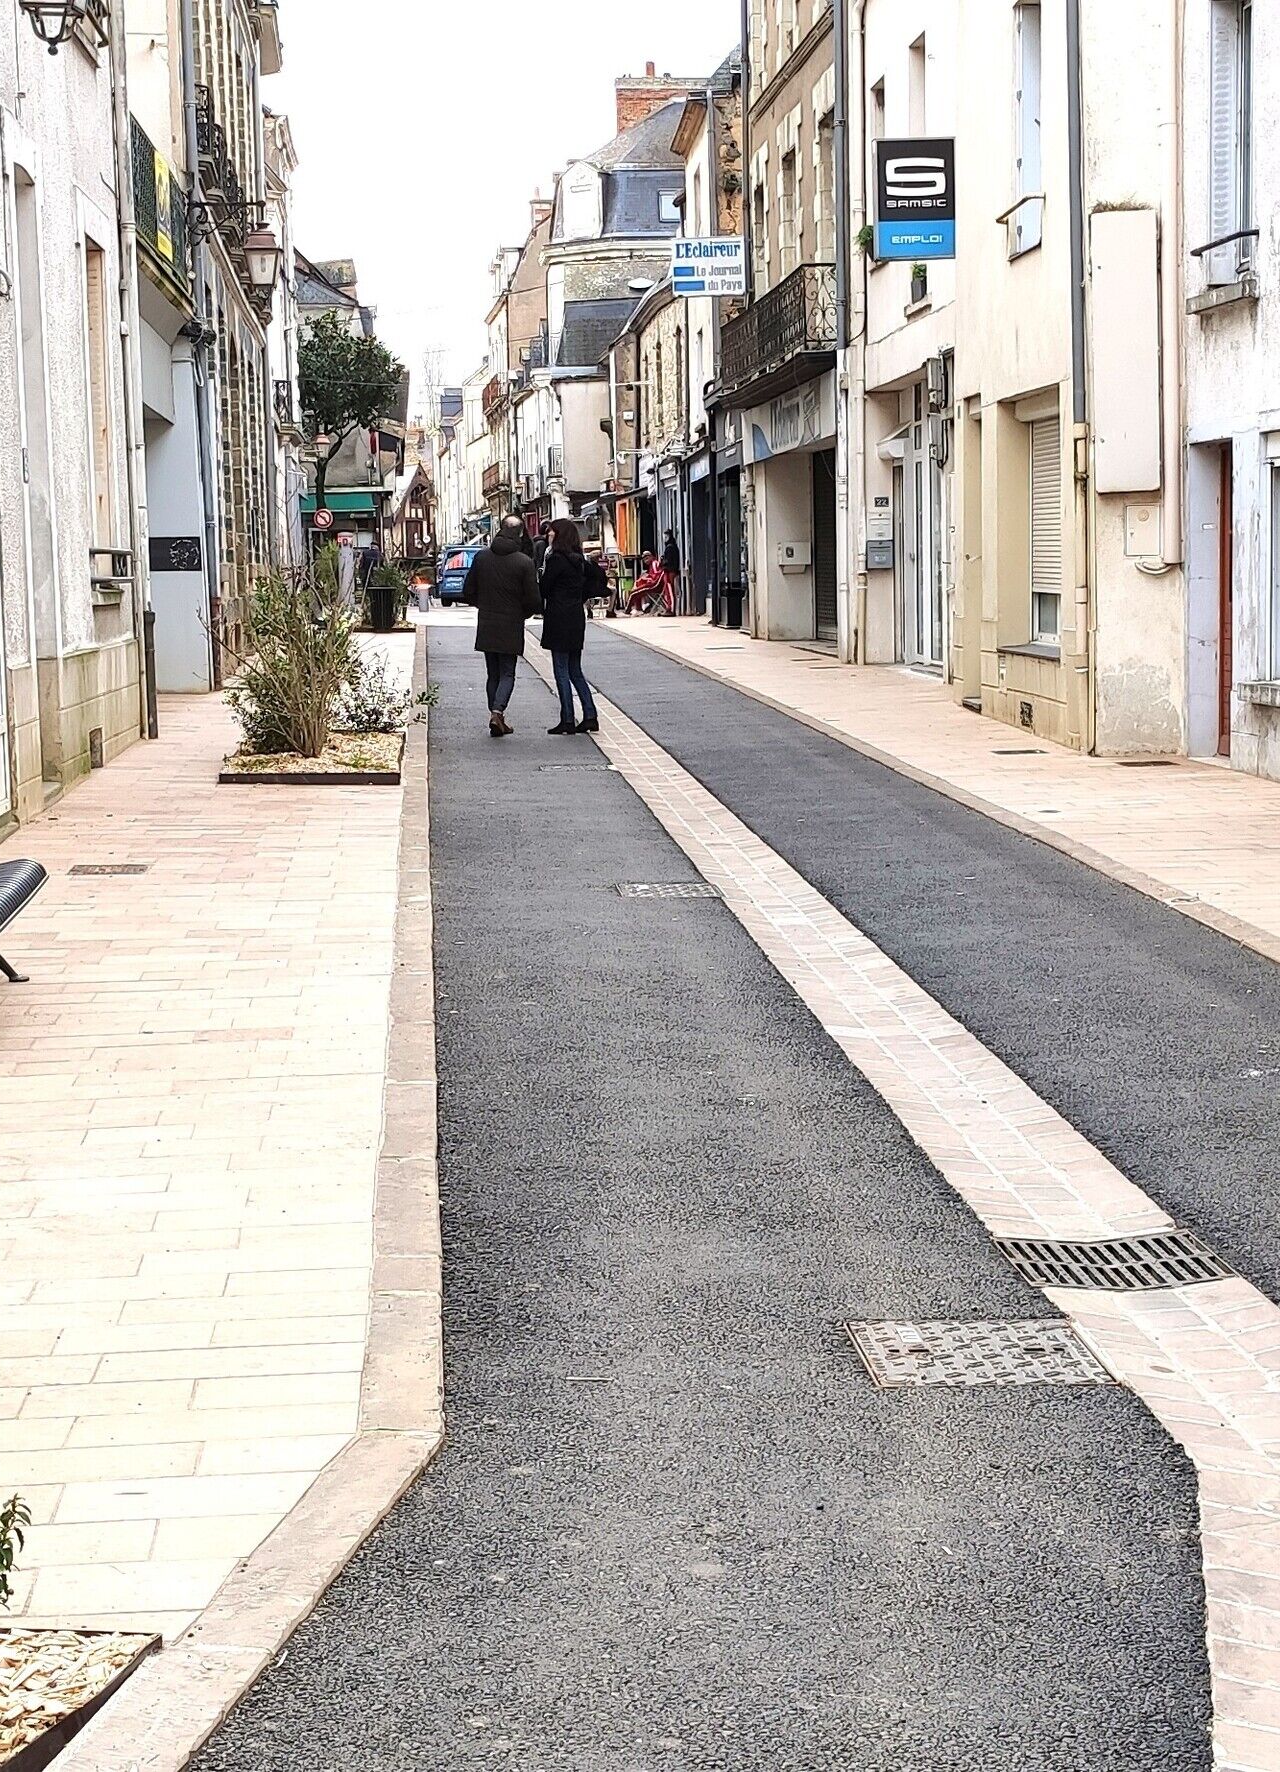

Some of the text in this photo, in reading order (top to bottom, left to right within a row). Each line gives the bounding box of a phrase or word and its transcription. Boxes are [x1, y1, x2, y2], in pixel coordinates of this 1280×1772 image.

[885, 157, 946, 197] S
[886, 199, 947, 208] SAMSIC
[891, 235, 943, 244] EMPLOI
[696, 264, 742, 277] Le Journal
[708, 279, 743, 291] du Pays
